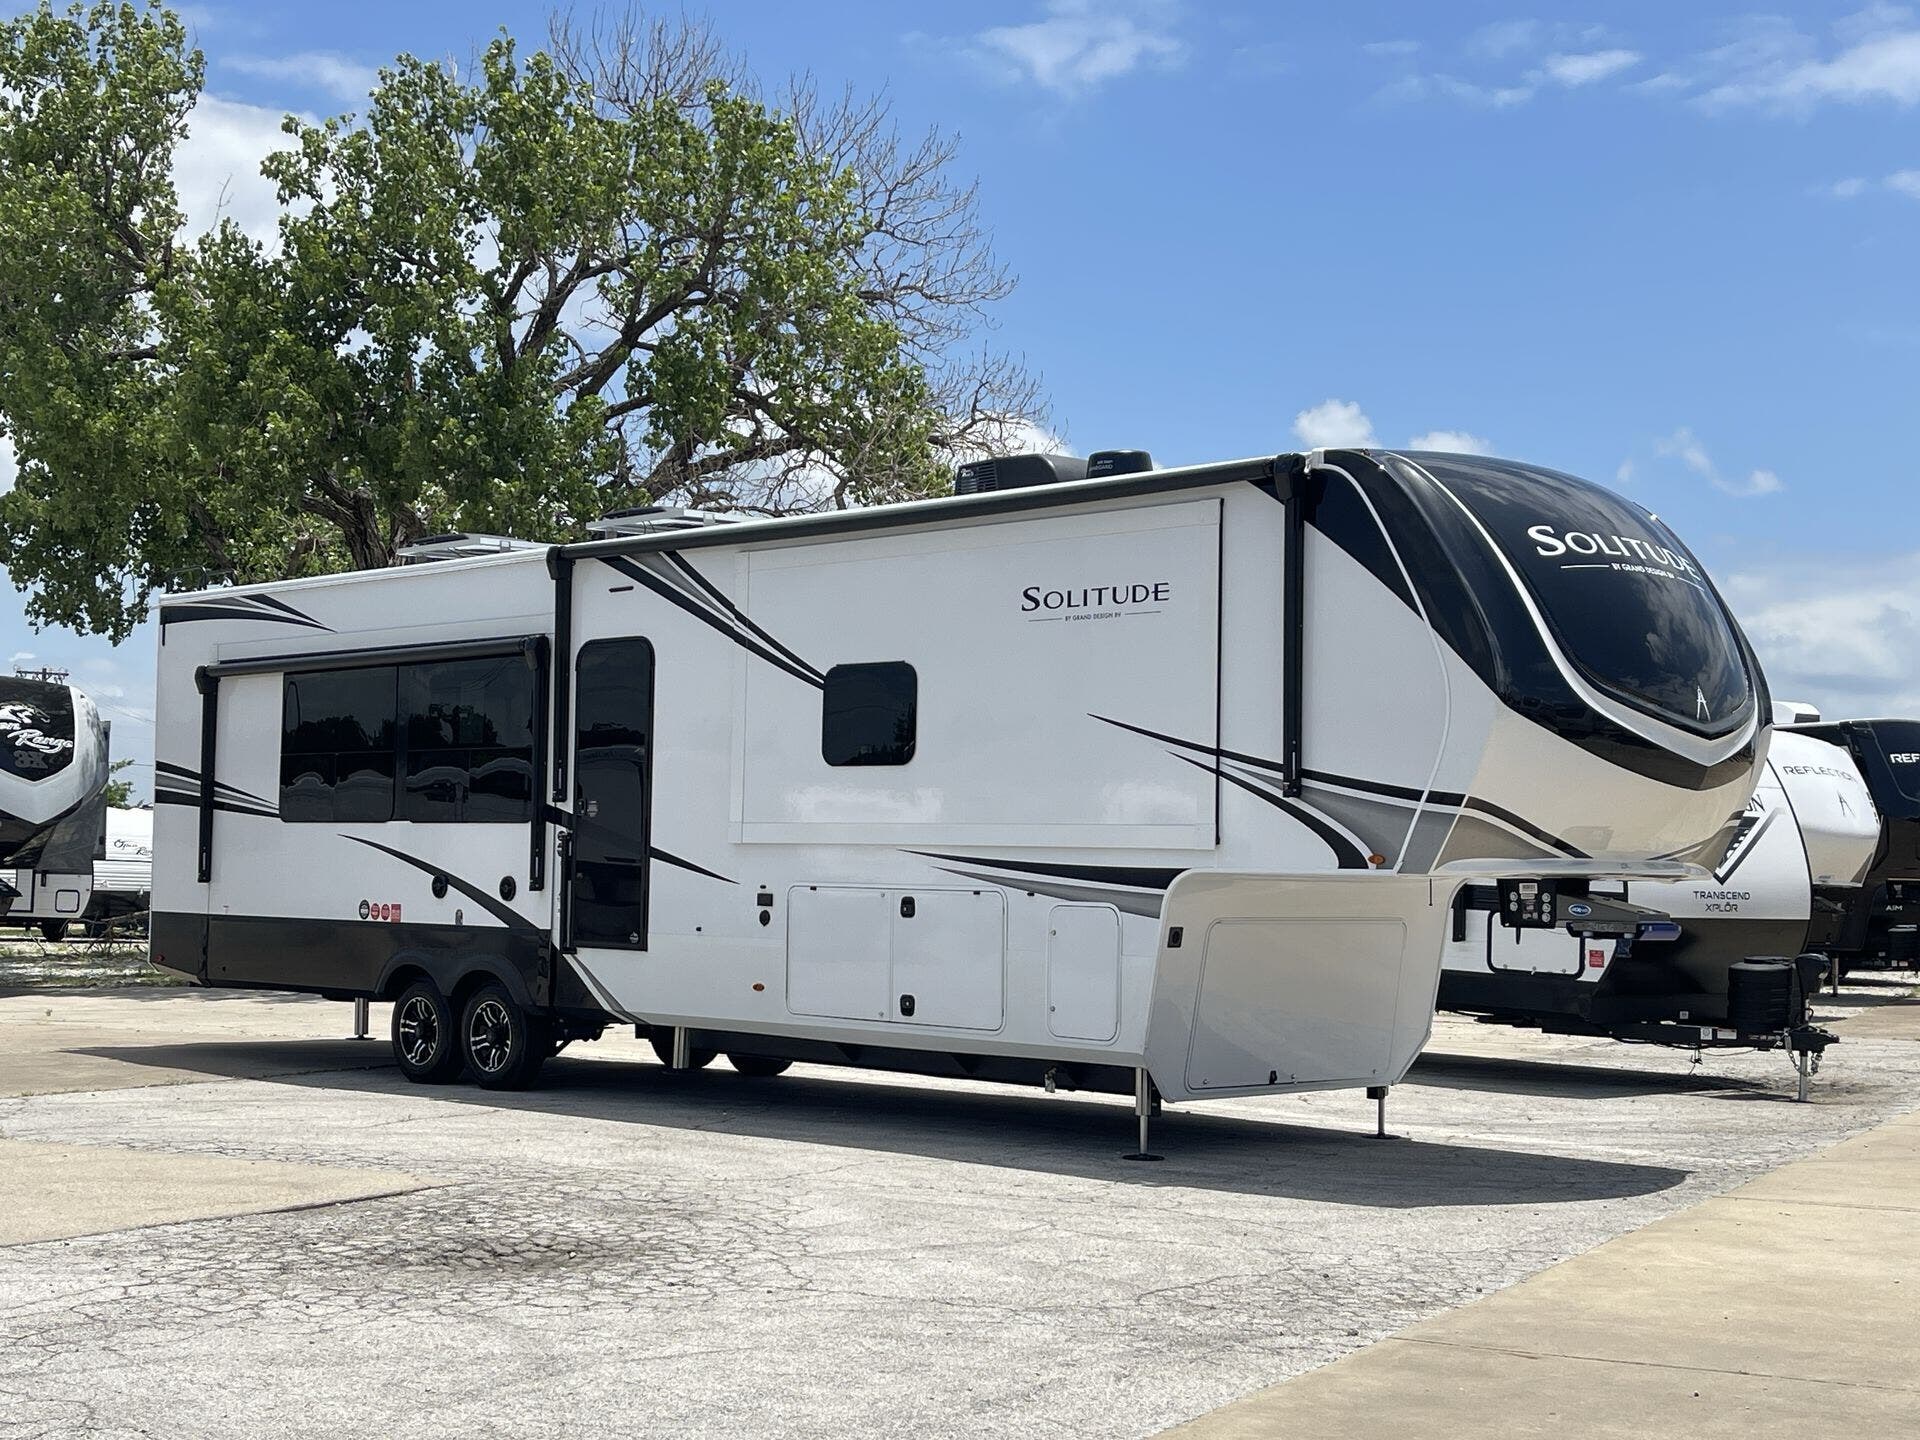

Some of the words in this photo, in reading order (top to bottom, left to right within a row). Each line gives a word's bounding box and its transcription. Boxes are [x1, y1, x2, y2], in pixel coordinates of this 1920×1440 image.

[1527, 525, 1701, 581] SOLITUDE
[1021, 582, 1170, 612] SOLITUDE
[1693, 891, 1750, 900] TRANSCEND
